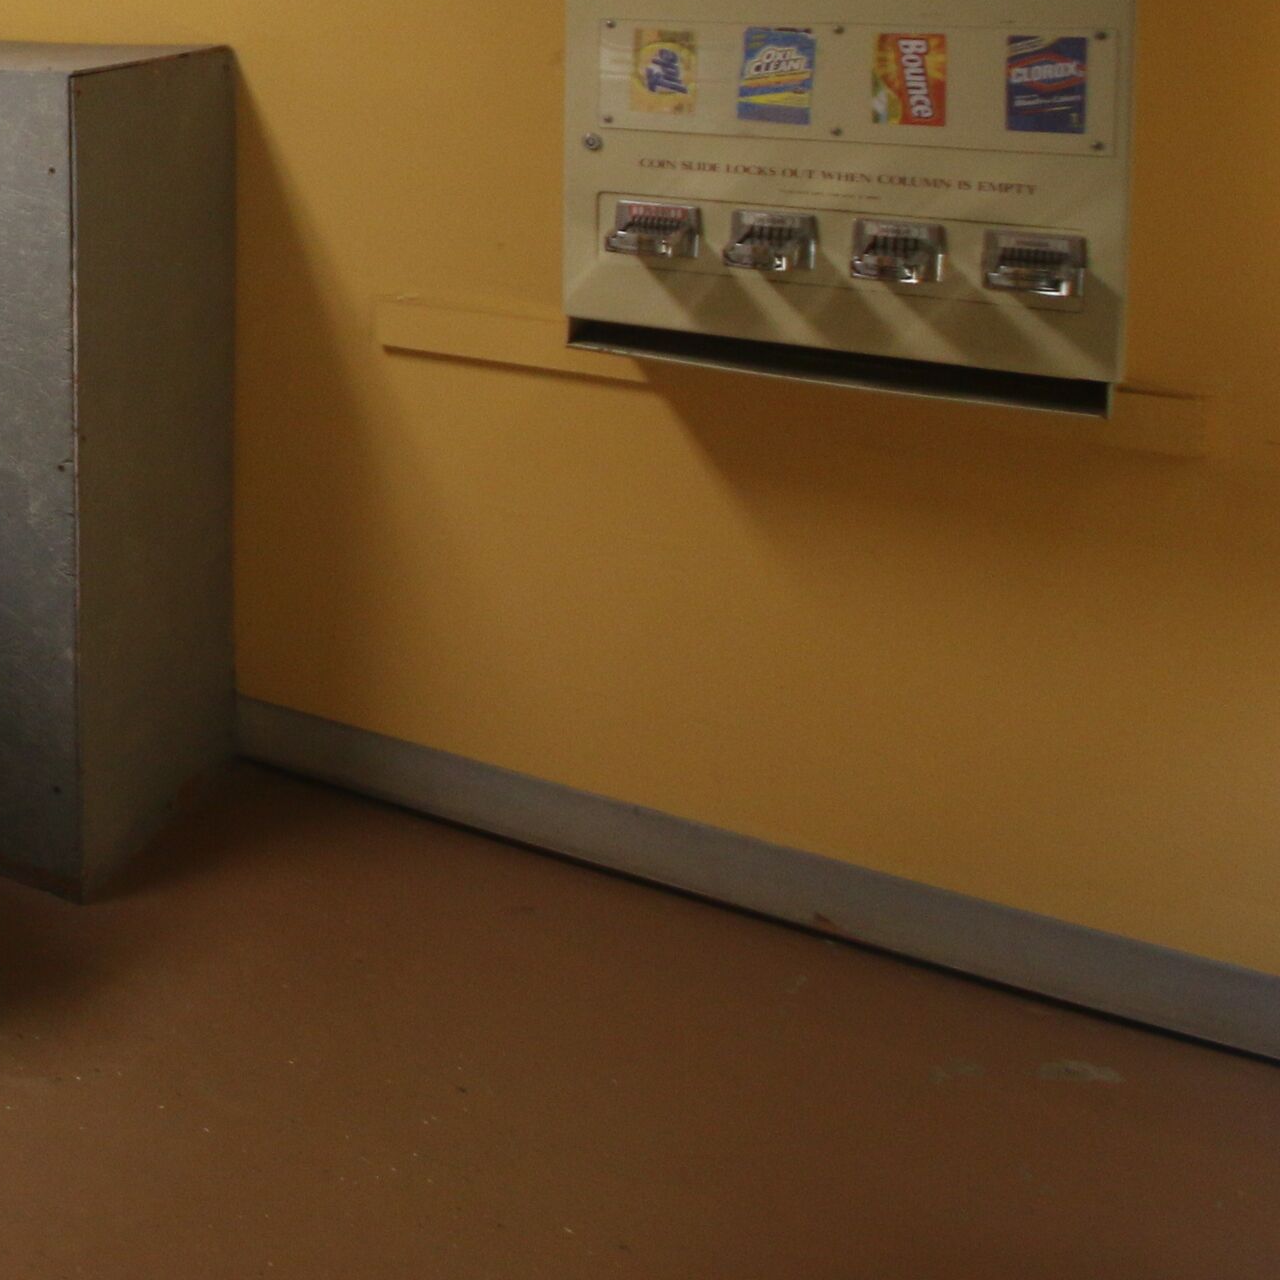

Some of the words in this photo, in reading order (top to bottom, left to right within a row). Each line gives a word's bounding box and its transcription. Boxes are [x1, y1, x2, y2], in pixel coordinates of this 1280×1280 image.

[645, 47, 689, 94] Tide
[749, 57, 806, 76] CLEAN
[897, 37, 934, 120] Bounce
[1009, 61, 1083, 83] CLOROX
[639, 157, 677, 170] COIN
[680, 160, 720, 173] SLIDE
[726, 164, 777, 177] LOCKS
[781, 168, 815, 180] OUT
[820, 170, 872, 184] WHEN
[876, 174, 953, 190] COLUMN
[957, 180, 972, 191] IS
[977, 181, 1038, 197] EMPTY
